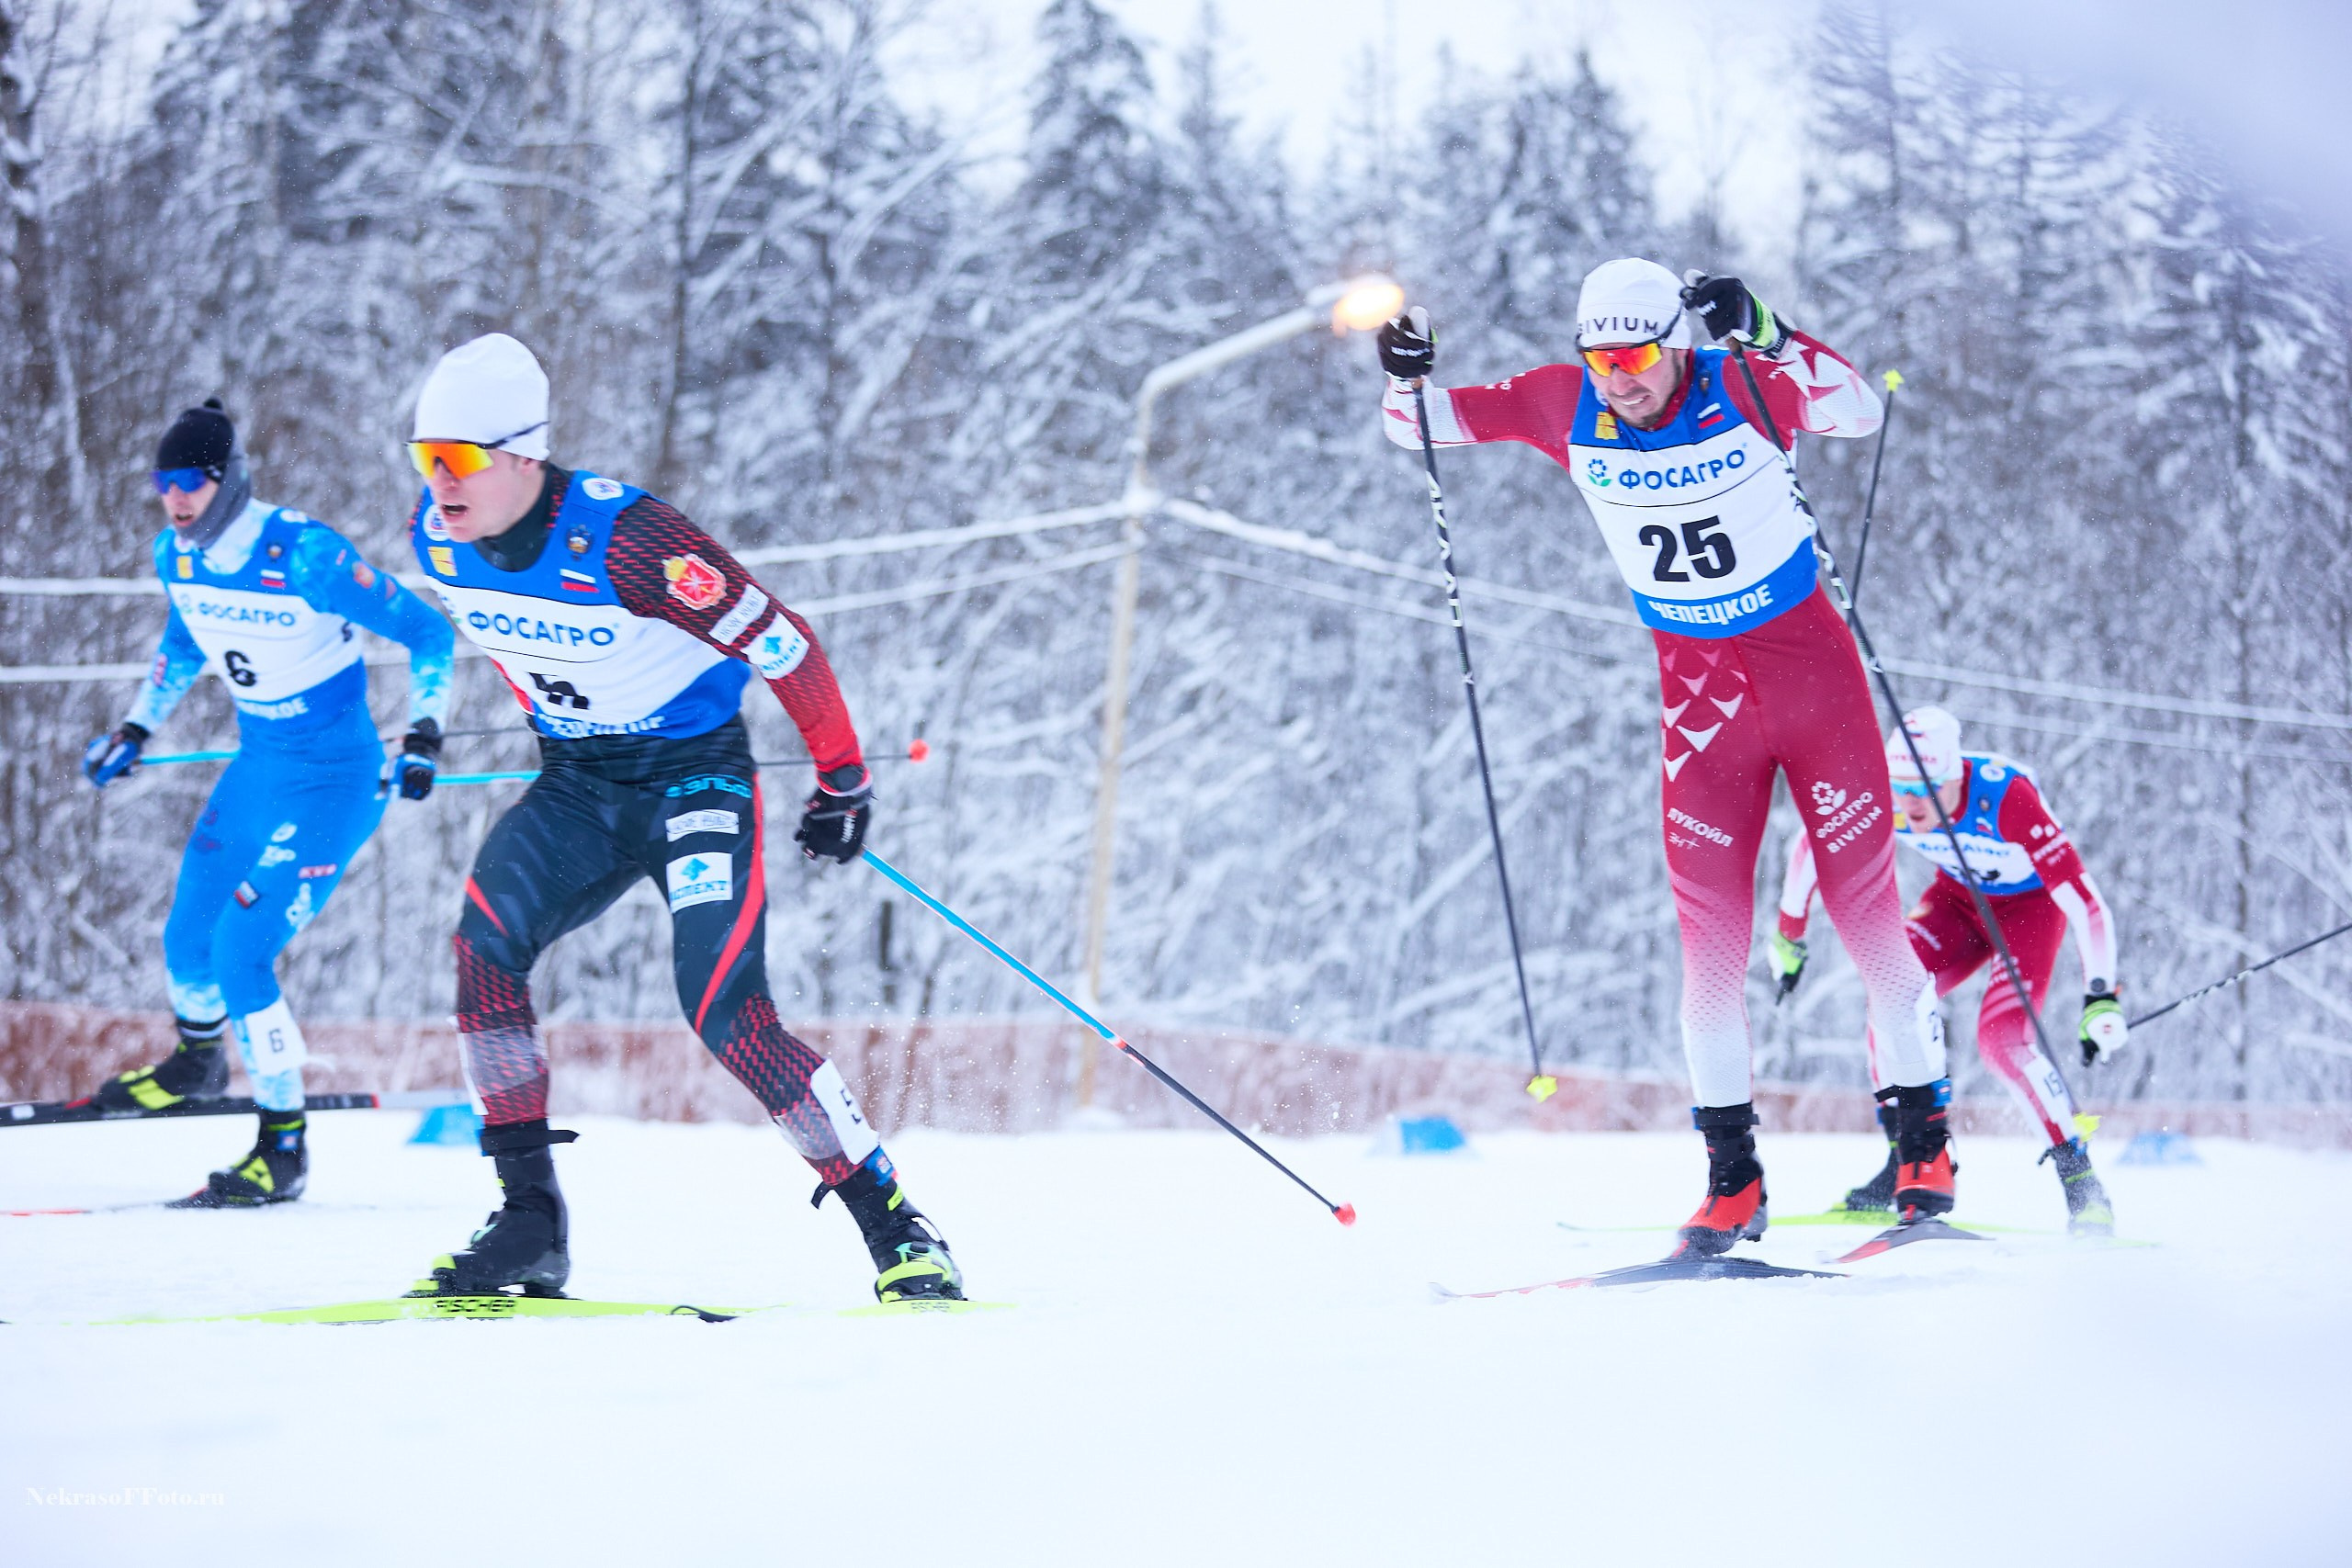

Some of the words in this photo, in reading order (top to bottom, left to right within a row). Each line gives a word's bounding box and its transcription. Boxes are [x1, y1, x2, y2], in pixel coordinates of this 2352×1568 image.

[1618, 449, 1746, 491] ФОСАГРО
[1639, 515, 1736, 582] 25
[1646, 583, 1774, 626] ЧЕПЕЦКОЕ
[468, 610, 615, 647] ФОСАГРО
[223, 649, 257, 687] 6
[1666, 807, 1735, 848] ЛУКОЙЛ
[1815, 791, 1873, 839] ФОСАГРО
[1826, 806, 1883, 854] BIVIUM
[267, 1028, 286, 1055] 6
